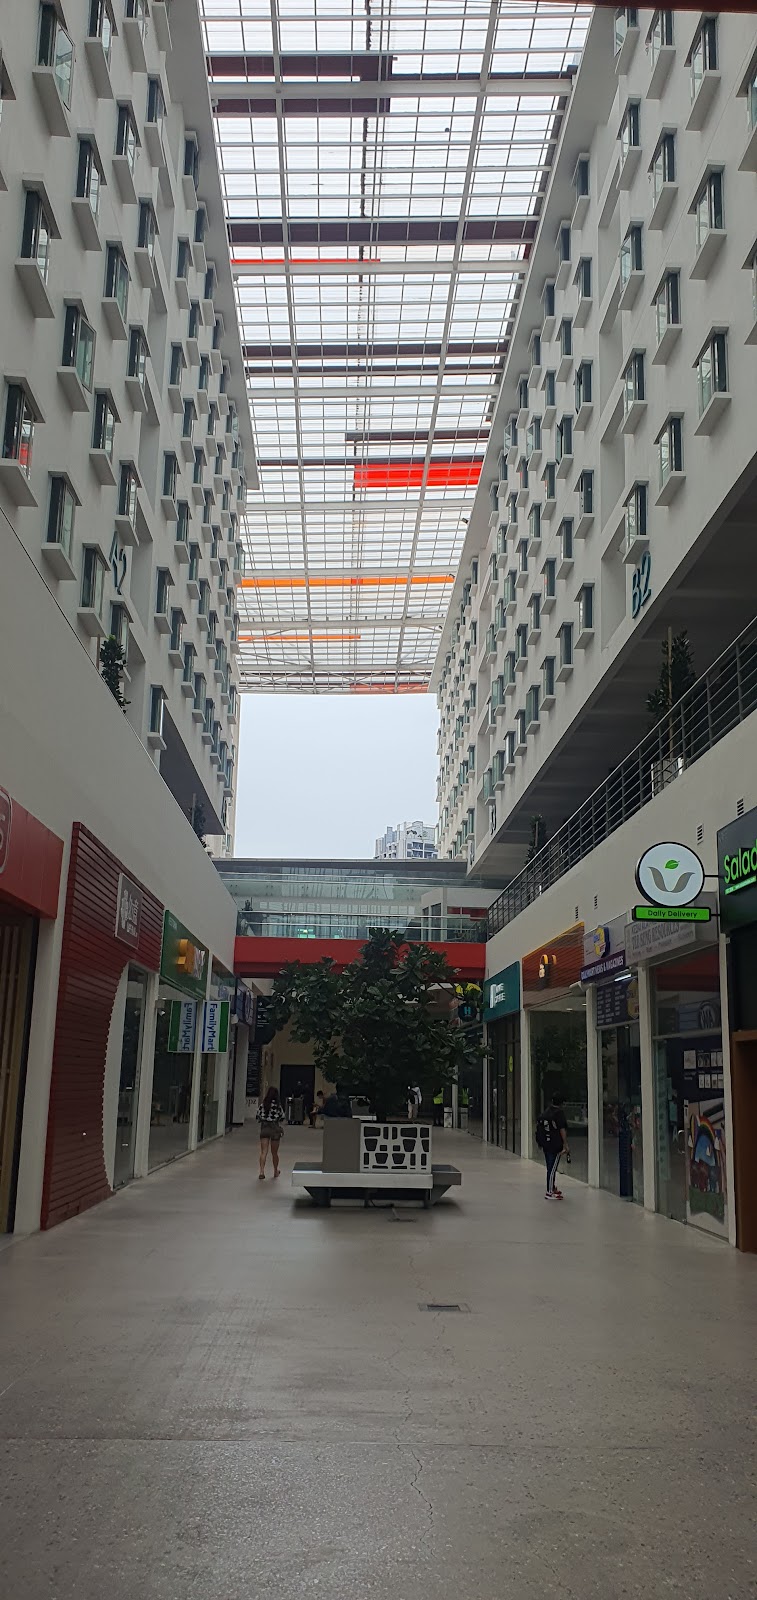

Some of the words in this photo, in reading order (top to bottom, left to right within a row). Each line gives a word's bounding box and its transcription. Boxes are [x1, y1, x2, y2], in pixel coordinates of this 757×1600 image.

[632, 550, 651, 619] B2
[647, 909, 667, 918] Daily
[667, 910, 698, 918] Delivery
[207, 1003, 218, 1051] FamilyMart
